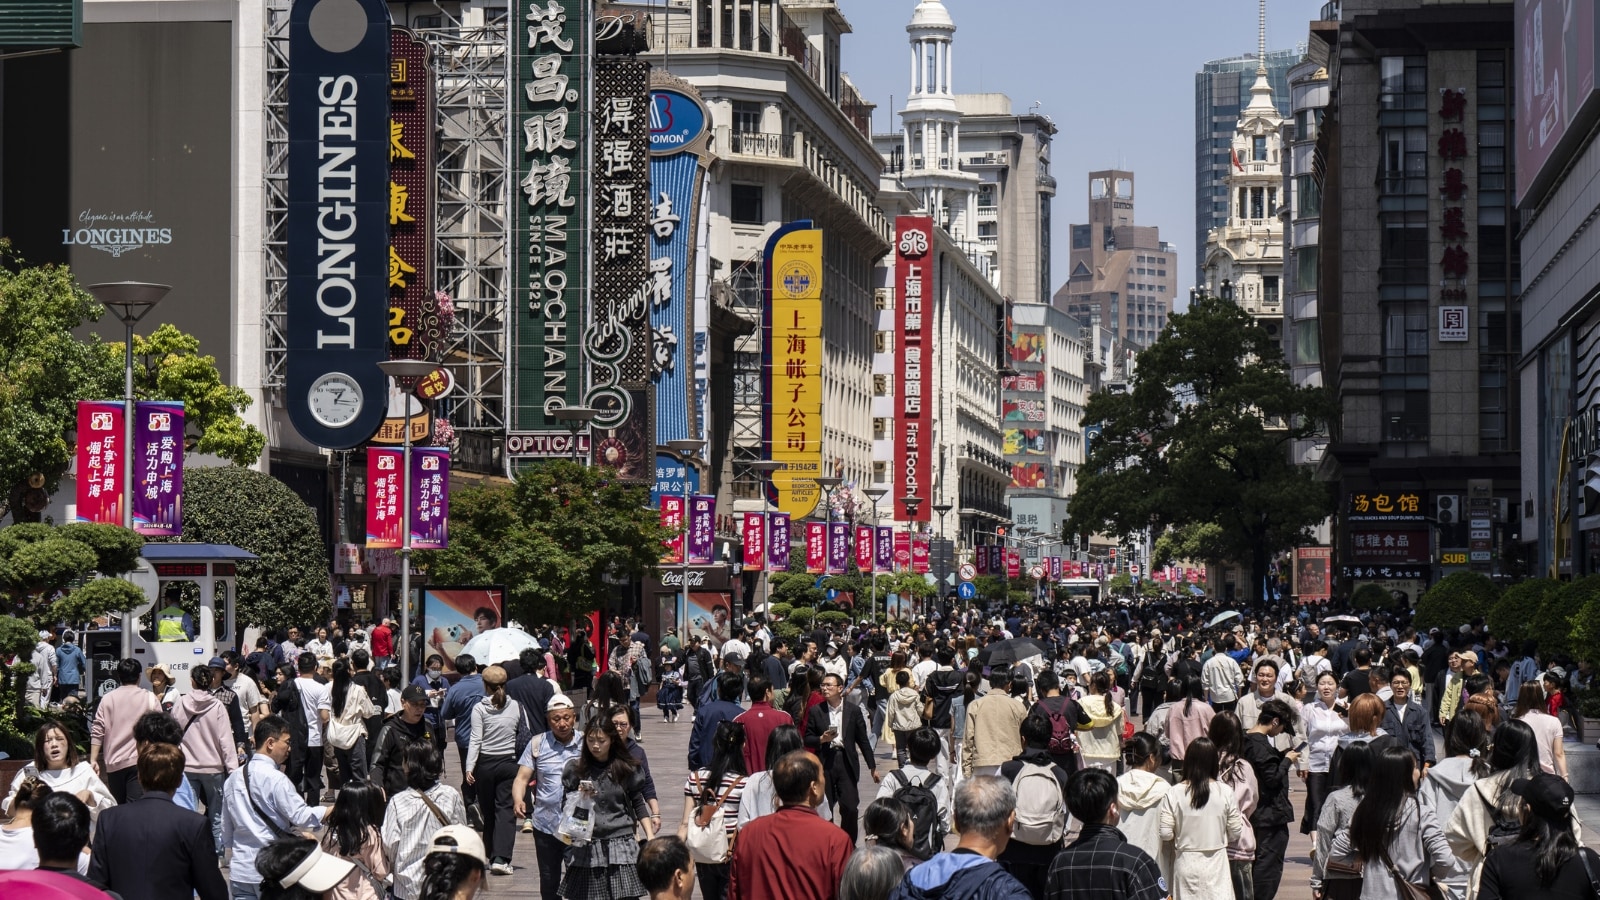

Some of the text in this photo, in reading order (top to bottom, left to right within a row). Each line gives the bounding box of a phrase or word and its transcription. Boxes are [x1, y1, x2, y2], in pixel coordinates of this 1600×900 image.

[520, 0, 577, 207] 茂昌眼镜
[62, 228, 172, 245] LONGINES
[317, 74, 358, 350] LONGINES
[530, 215, 542, 311] SINCE 1923
[545, 215, 568, 417] MAOCHANG
[905, 263, 922, 413] 上海市第一食品商店
[786, 310, 806, 453] 上海帐子公司
[508, 435, 589, 451] OPTICAL
[695, 378, 707, 459] Pharmay
[906, 422, 919, 448] First
[87, 441, 102, 498] 潮起上海
[103, 435, 115, 491] 乐享消费
[145, 442, 159, 500] 活力申城
[160, 436, 174, 493] 爱购上海
[1016, 514, 1038, 525] 退税
[1354, 493, 1419, 513] 汤包馆
[1355, 534, 1409, 547] 新雅食品
